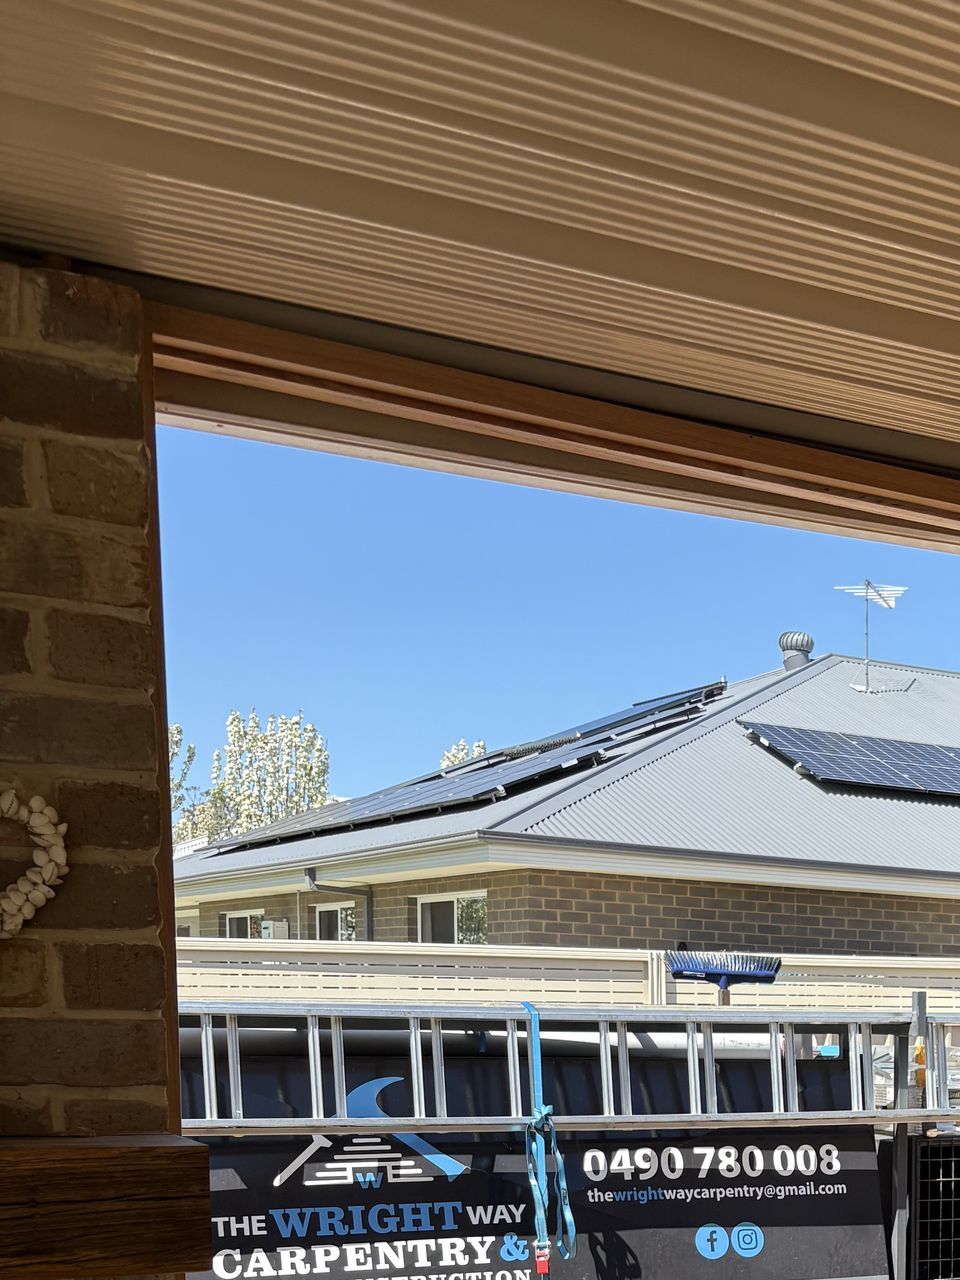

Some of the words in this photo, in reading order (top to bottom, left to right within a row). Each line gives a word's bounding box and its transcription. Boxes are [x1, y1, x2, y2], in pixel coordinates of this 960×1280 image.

[356, 1172, 383, 1189] W
[582, 1147, 684, 1182] 0490
[693, 1145, 764, 1179] 780
[773, 1144, 841, 1178] 008
[587, 1181, 847, 1205] thewrightwaycarpentry@gmail.com
[212, 1215, 267, 1238] THE
[269, 1201, 462, 1239] WRIGHT
[466, 1204, 527, 1225] WAY
[212, 1235, 496, 1280] CARPENTRY
[500, 1231, 529, 1262] &
